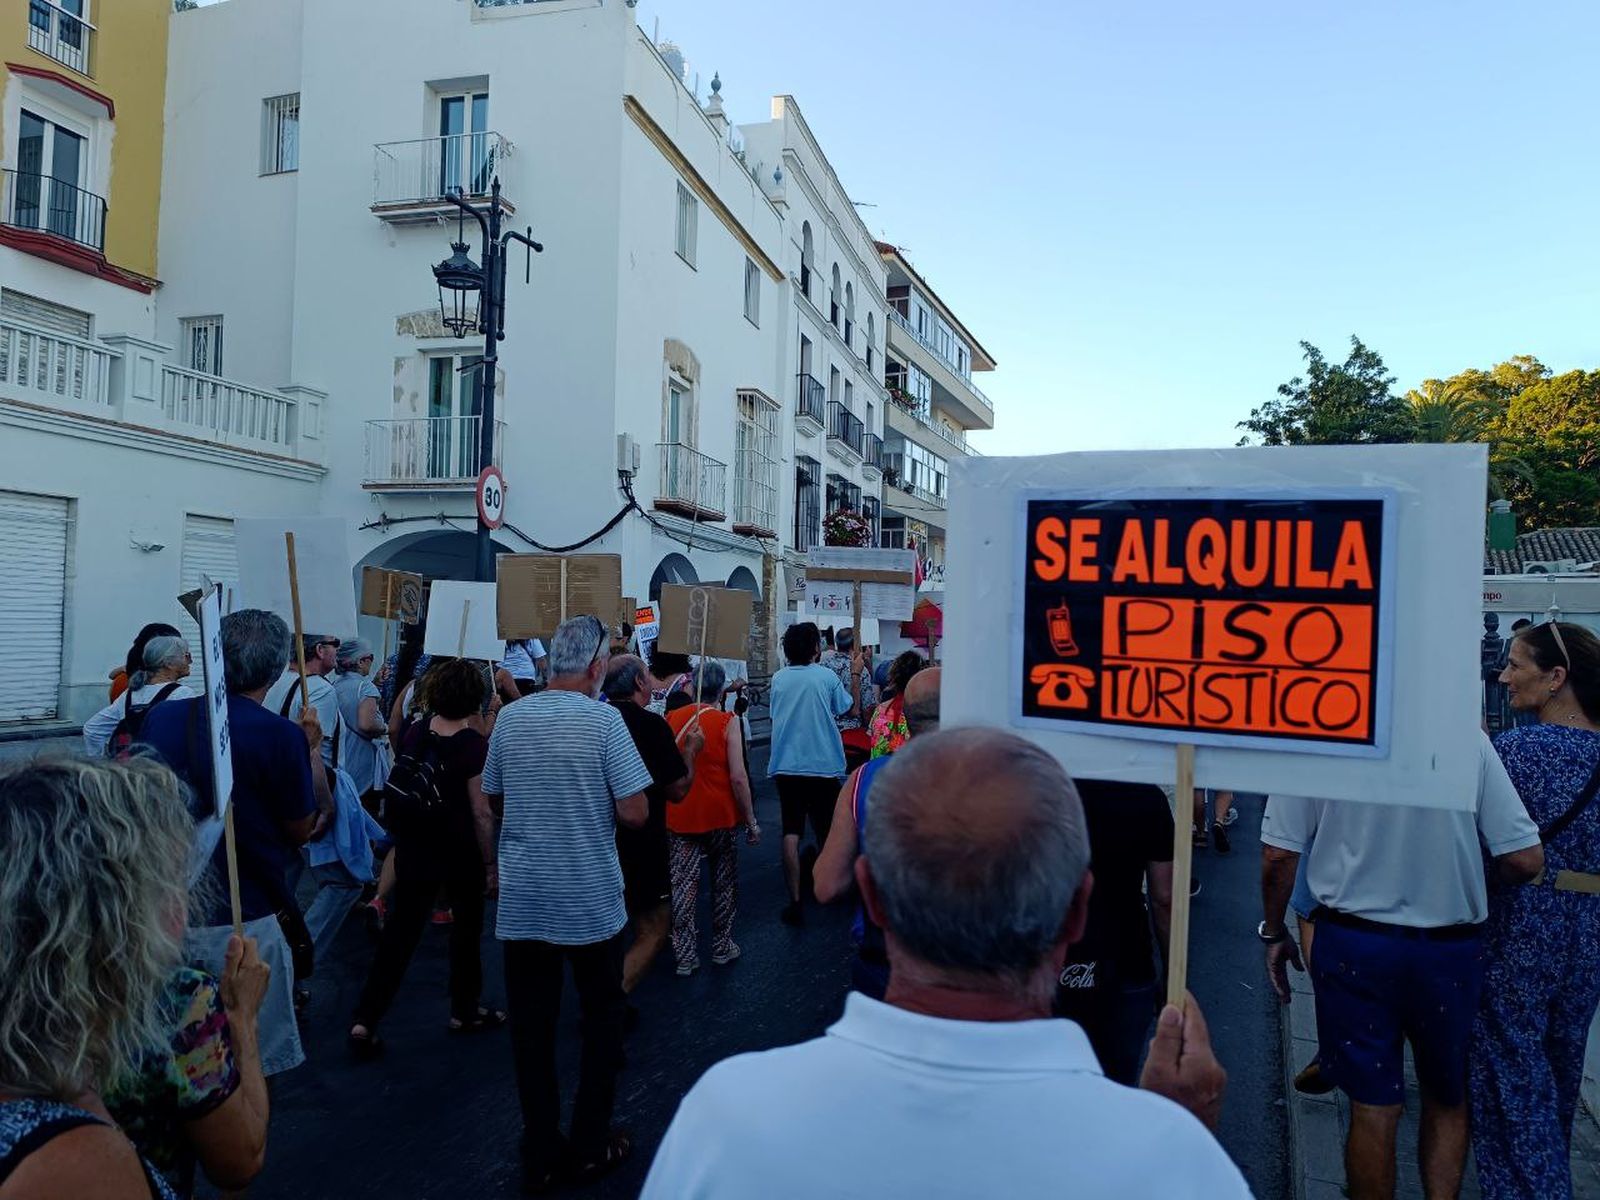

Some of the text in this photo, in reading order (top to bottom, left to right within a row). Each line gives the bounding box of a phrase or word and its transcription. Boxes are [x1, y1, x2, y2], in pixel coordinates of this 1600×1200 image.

[485, 487, 501, 509] 30
[1034, 517, 1374, 590] SE ALQUILA
